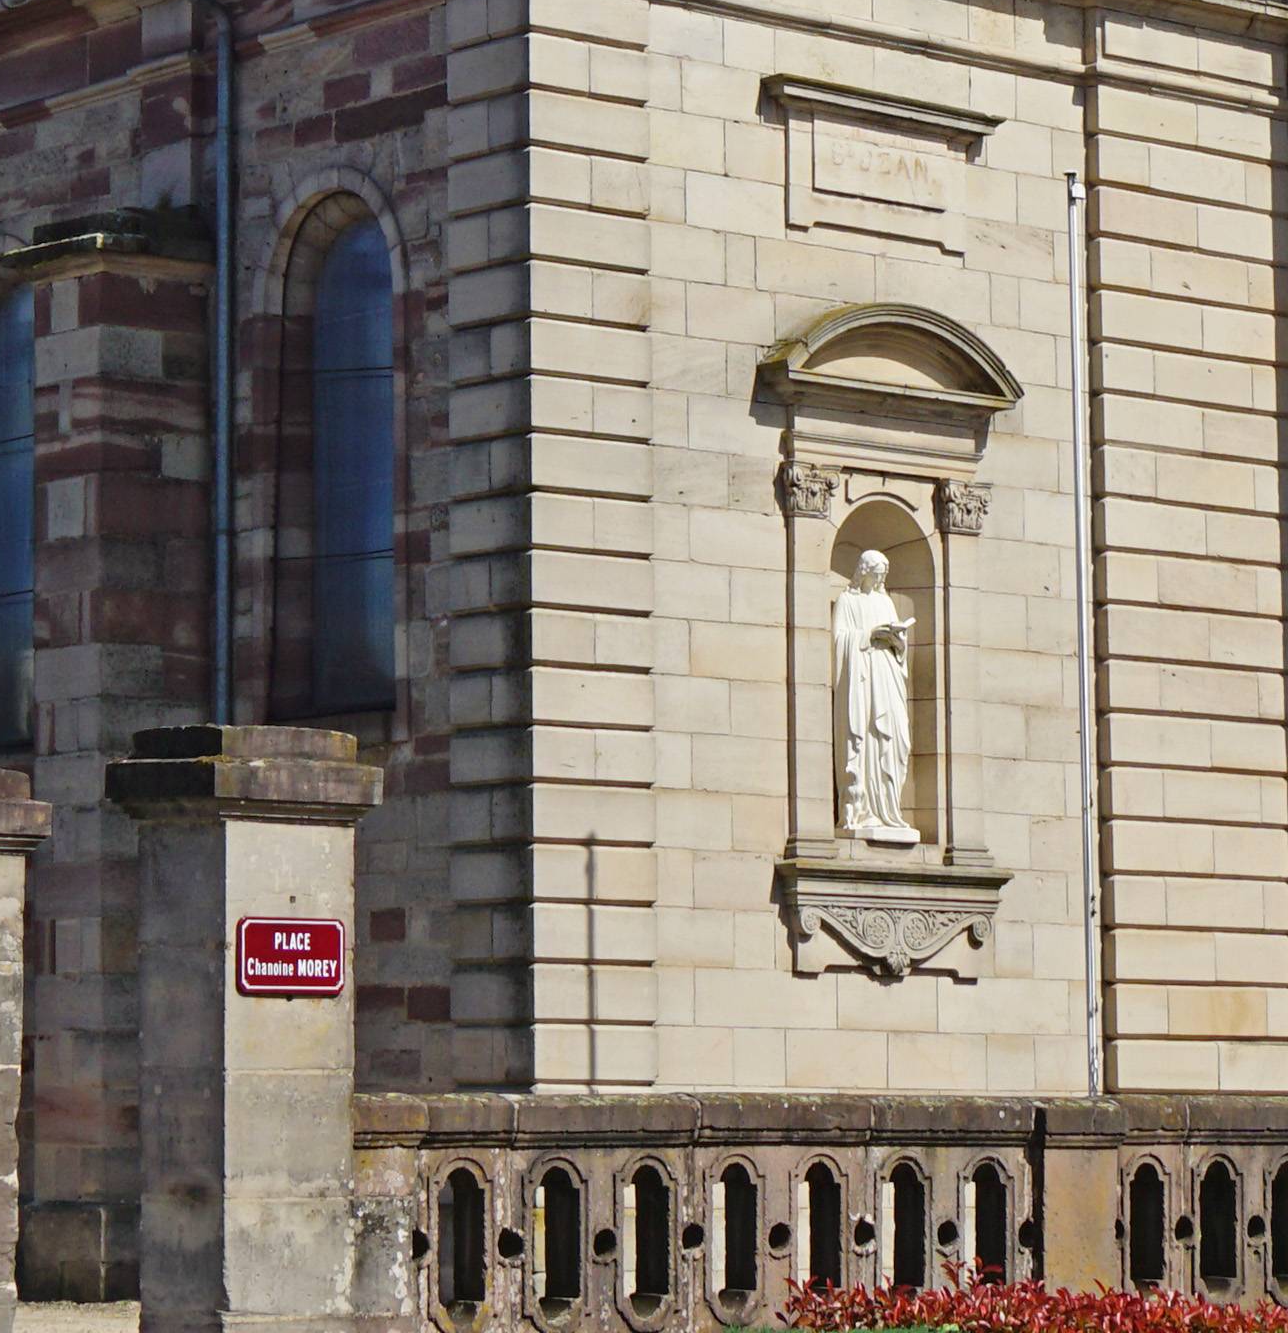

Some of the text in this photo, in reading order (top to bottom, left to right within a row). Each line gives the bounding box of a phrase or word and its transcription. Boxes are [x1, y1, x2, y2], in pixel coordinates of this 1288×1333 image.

[274, 932, 311, 951] PLACE
[247, 957, 337, 978] Chanoine MOREY
